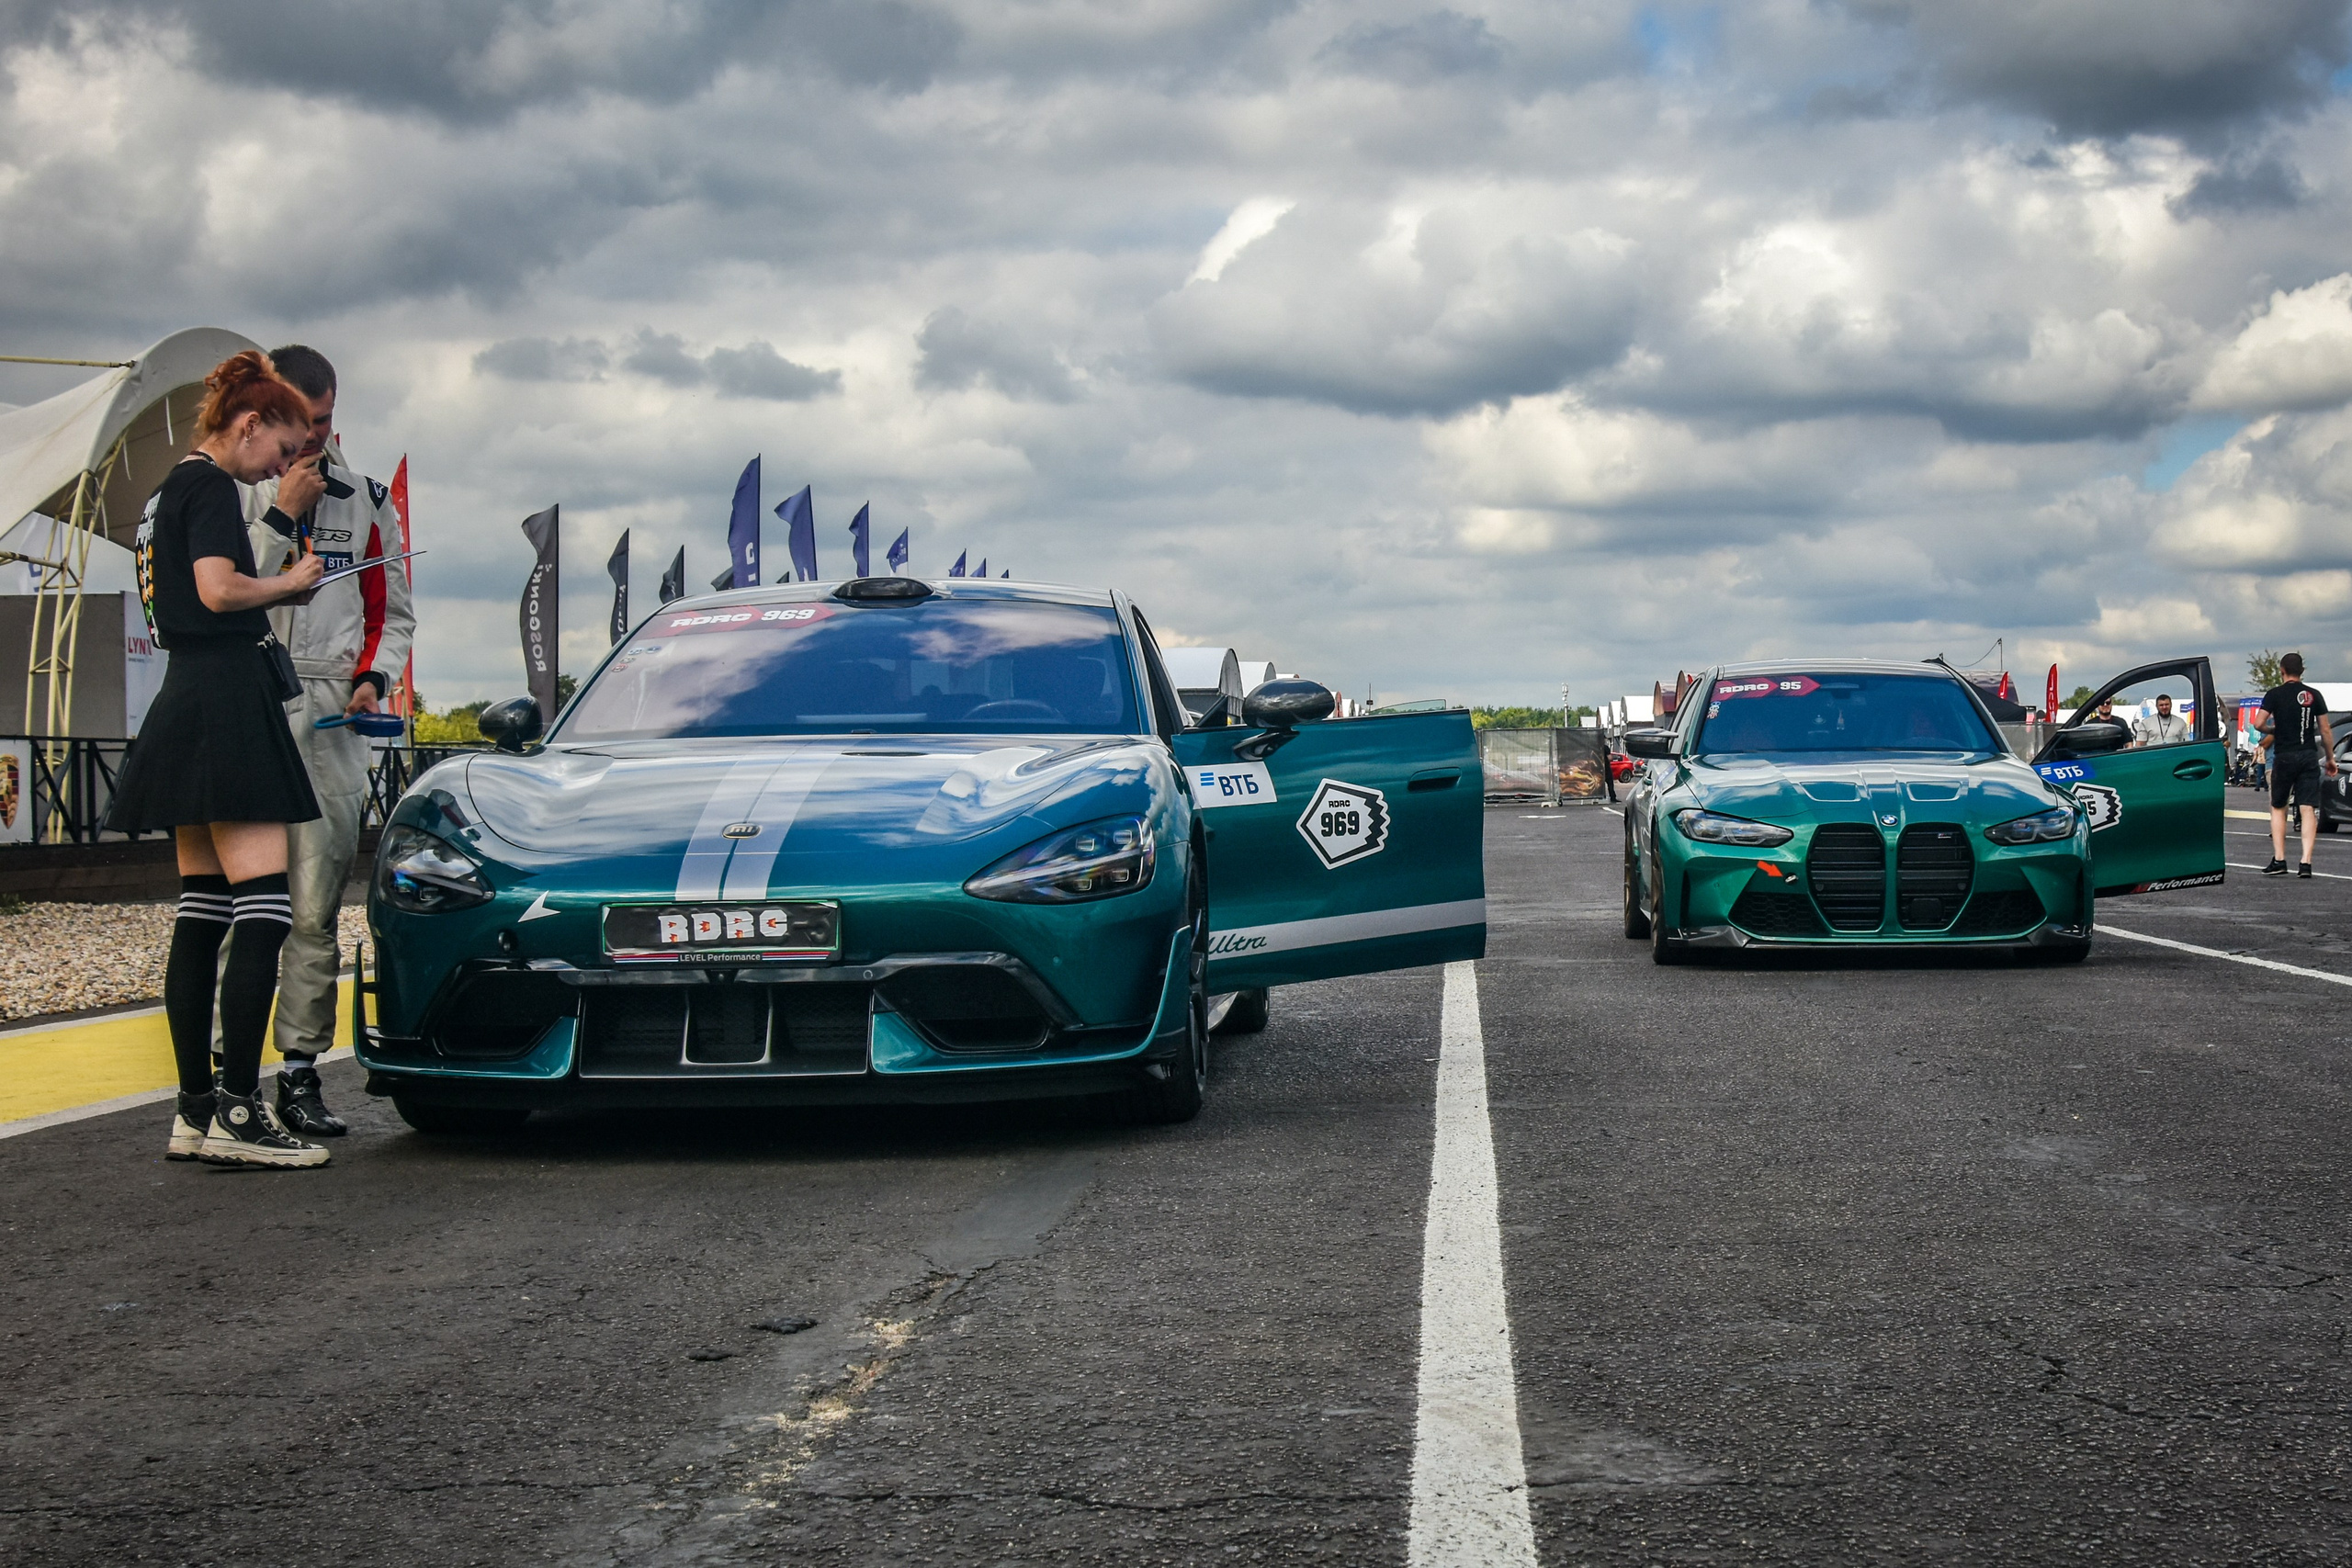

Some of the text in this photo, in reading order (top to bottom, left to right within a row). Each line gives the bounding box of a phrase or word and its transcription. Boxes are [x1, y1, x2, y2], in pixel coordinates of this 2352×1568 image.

[670, 609, 816, 627] RDRC 969
[1719, 682, 1802, 694] RDRC 95
[2053, 765, 2084, 779] ВТБ
[1218, 774, 1260, 796] ВТБ
[1321, 811, 1359, 837] 969
[2146, 874, 2222, 891] Performance
[658, 909, 787, 943] RDRC
[1208, 933, 1267, 954] Ultra
[680, 953, 761, 962] LEVEL Performance
